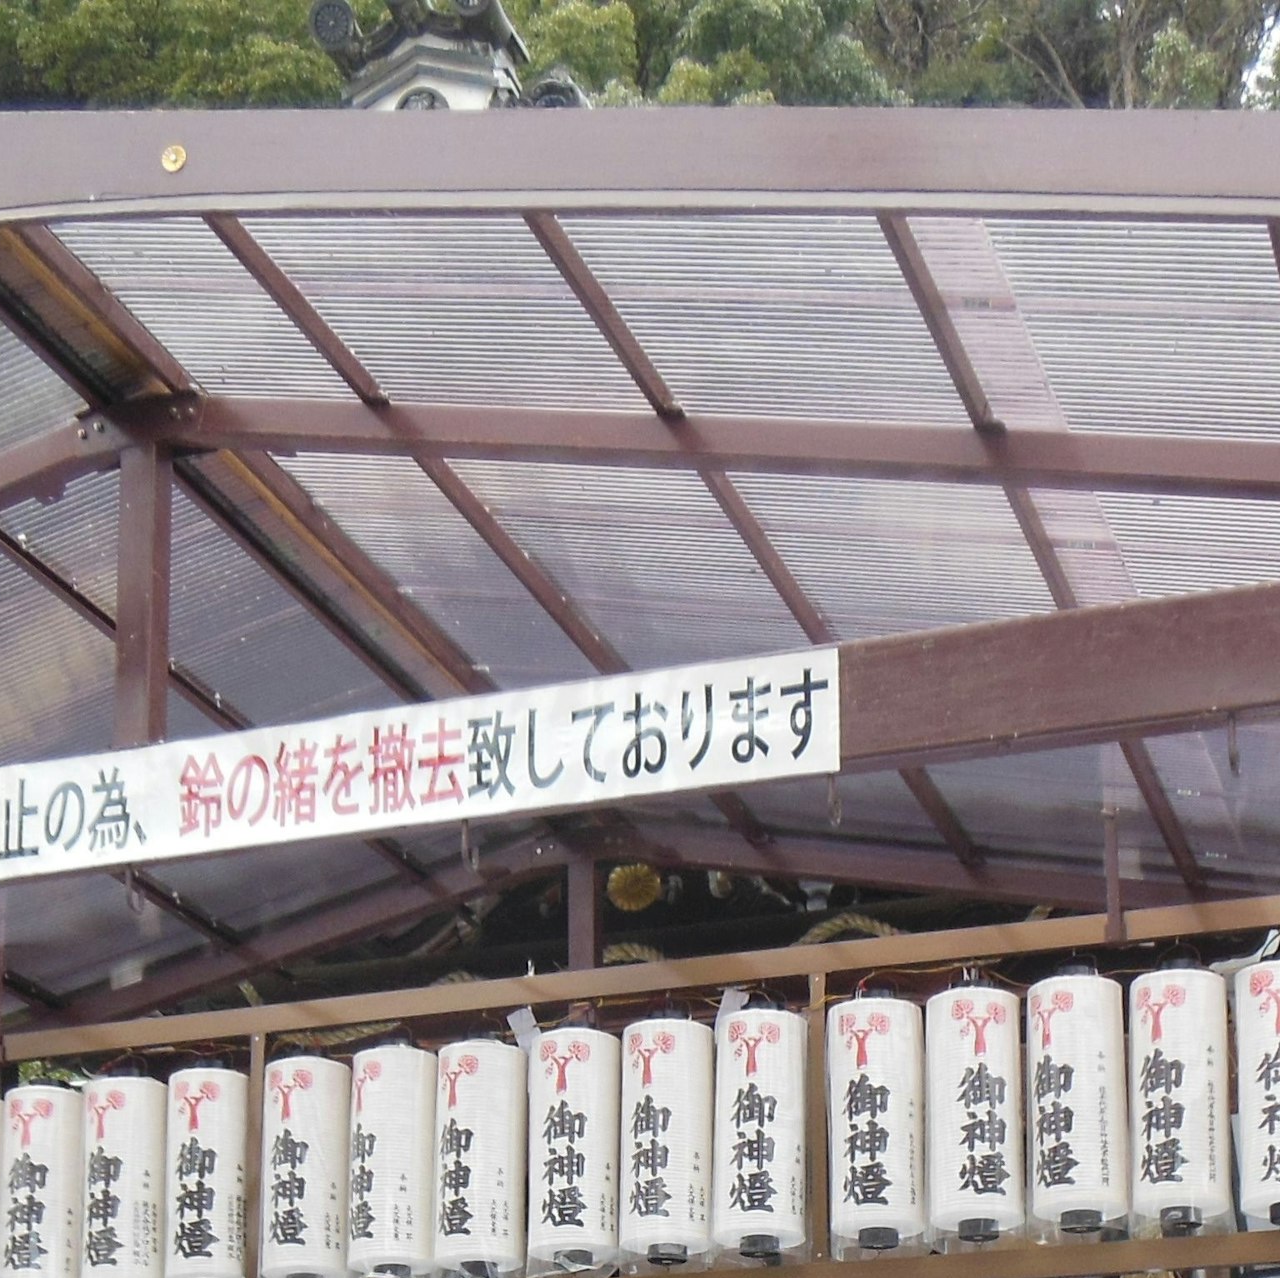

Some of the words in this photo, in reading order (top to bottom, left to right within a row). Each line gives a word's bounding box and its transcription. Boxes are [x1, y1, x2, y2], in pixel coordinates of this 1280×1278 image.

[541, 1100, 588, 1228] 御神燈
[629, 1095, 672, 1217] 御神燈
[728, 1083, 778, 1213] 御神燈
[842, 1074, 893, 1206] 御神燈
[957, 1063, 1011, 1195] 御神燈
[1034, 1055, 1080, 1188] 御神燈
[1140, 1049, 1189, 1185] 御神燈
[4, 1153, 49, 1270] 御神燈
[174, 1137, 220, 1259] 御神燈
[269, 1129, 309, 1245] 御神燈
